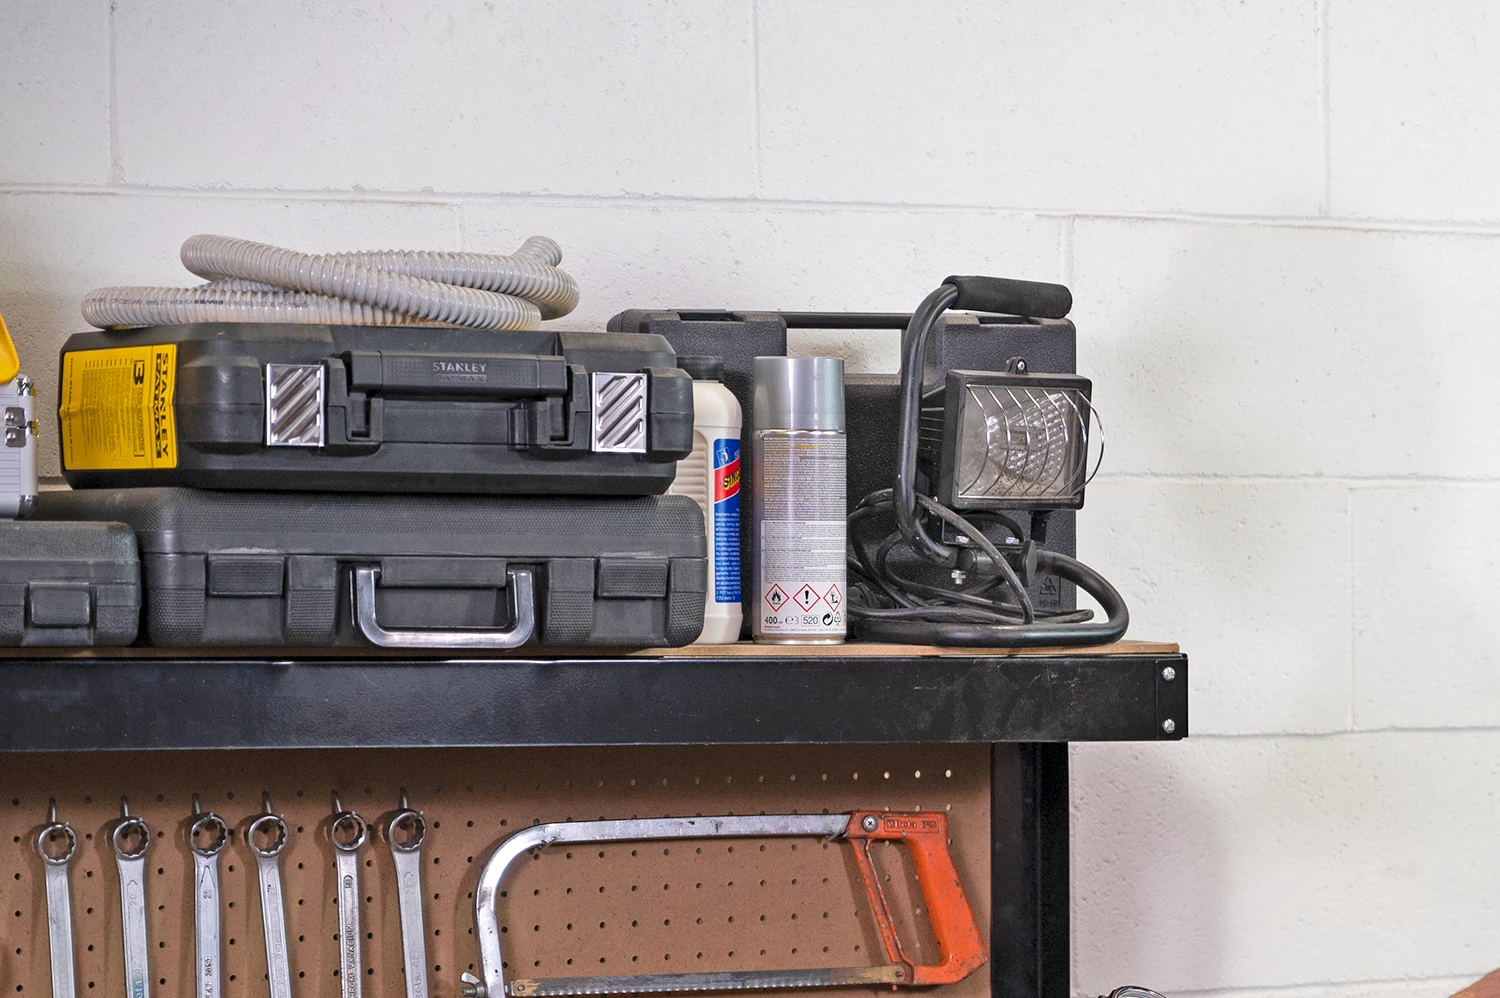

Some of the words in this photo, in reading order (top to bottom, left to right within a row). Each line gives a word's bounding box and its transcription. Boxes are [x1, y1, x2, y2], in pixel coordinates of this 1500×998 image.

[433, 361, 487, 373] STANLEY
[134, 362, 145, 385] 3
[160, 353, 169, 457] STANLEY
[764, 616, 778, 625] 400
[802, 616, 819, 625] 520
